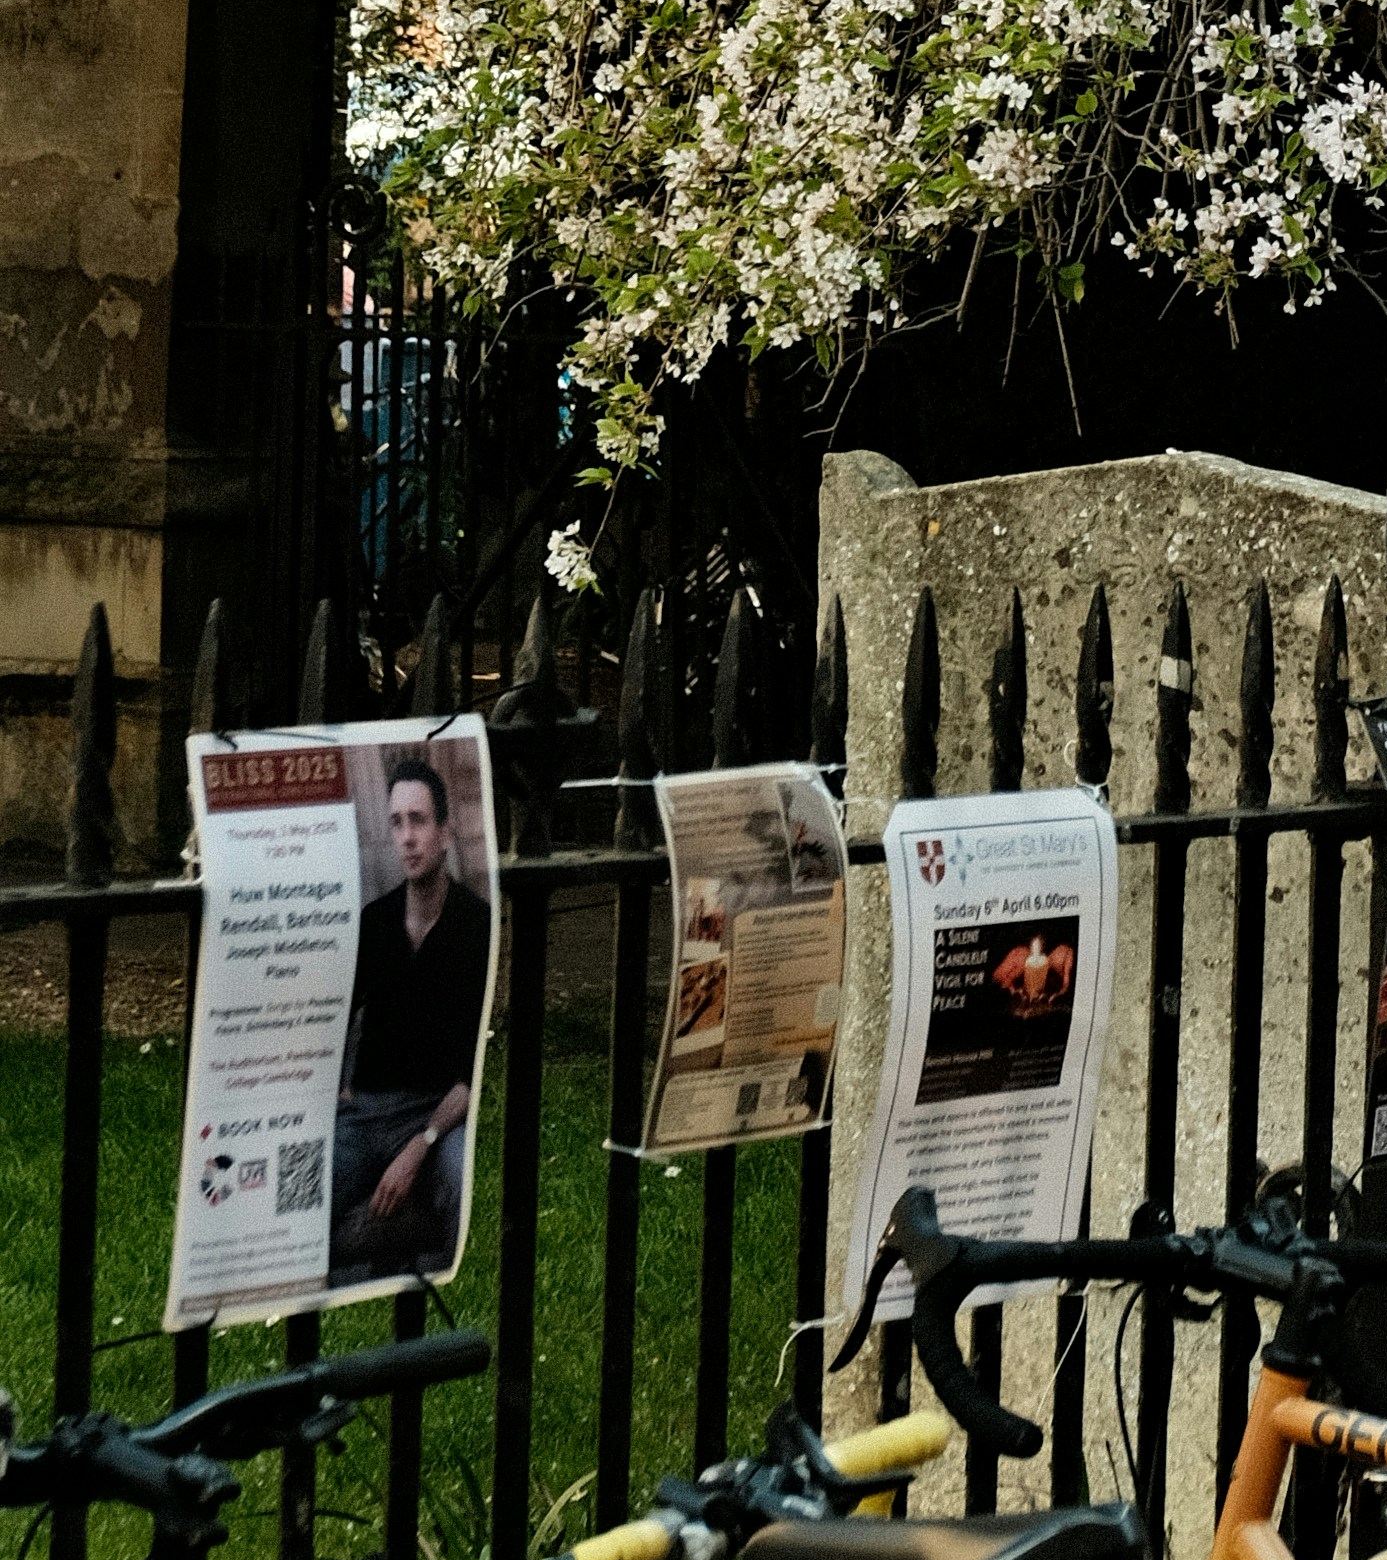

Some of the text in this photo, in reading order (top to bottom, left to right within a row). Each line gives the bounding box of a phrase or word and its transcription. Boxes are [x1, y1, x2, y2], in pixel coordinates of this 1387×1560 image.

[206, 753, 339, 790] BLISS 2025
[267, 881, 344, 902] Montague
[934, 903, 981, 921] Sunday
[1002, 897, 1031, 917] April
[1033, 892, 1080, 913] 6.00pm
[286, 909, 352, 931] Baritone
[936, 931, 945, 947] A
[932, 994, 967, 1012] PEACE
[218, 1111, 306, 1140] BOOK NOW
